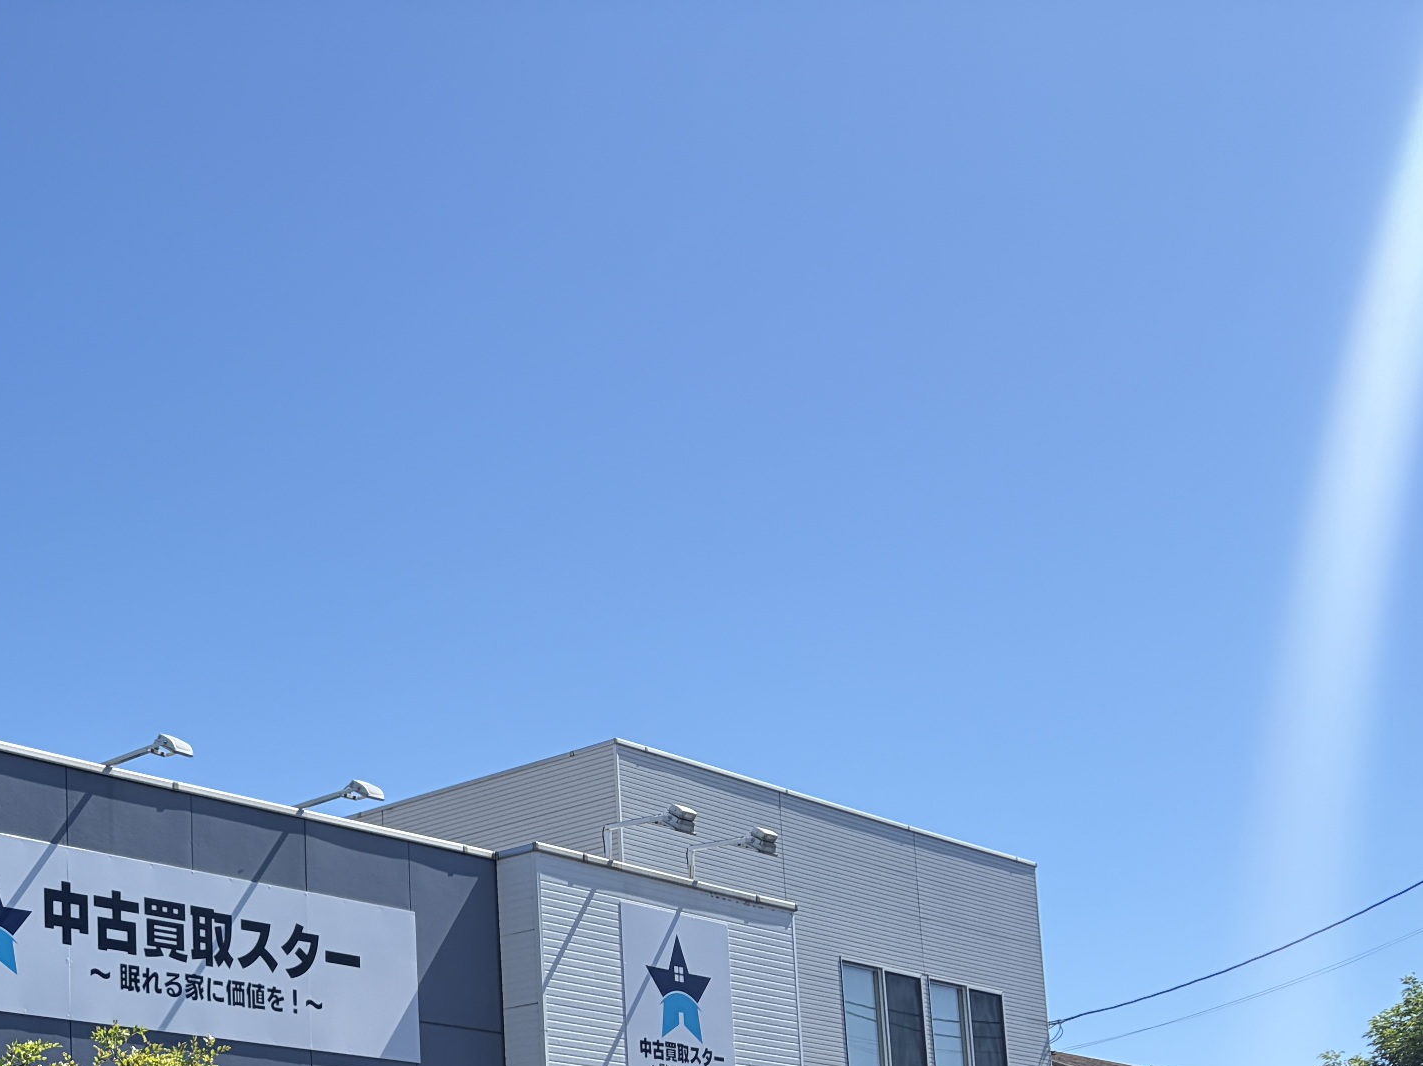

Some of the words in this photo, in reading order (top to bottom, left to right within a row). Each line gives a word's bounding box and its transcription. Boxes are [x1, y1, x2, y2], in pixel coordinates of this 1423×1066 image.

[43, 880, 361, 980] 中古買取スター
[639, 1037, 724, 1066] 中古買取スター
